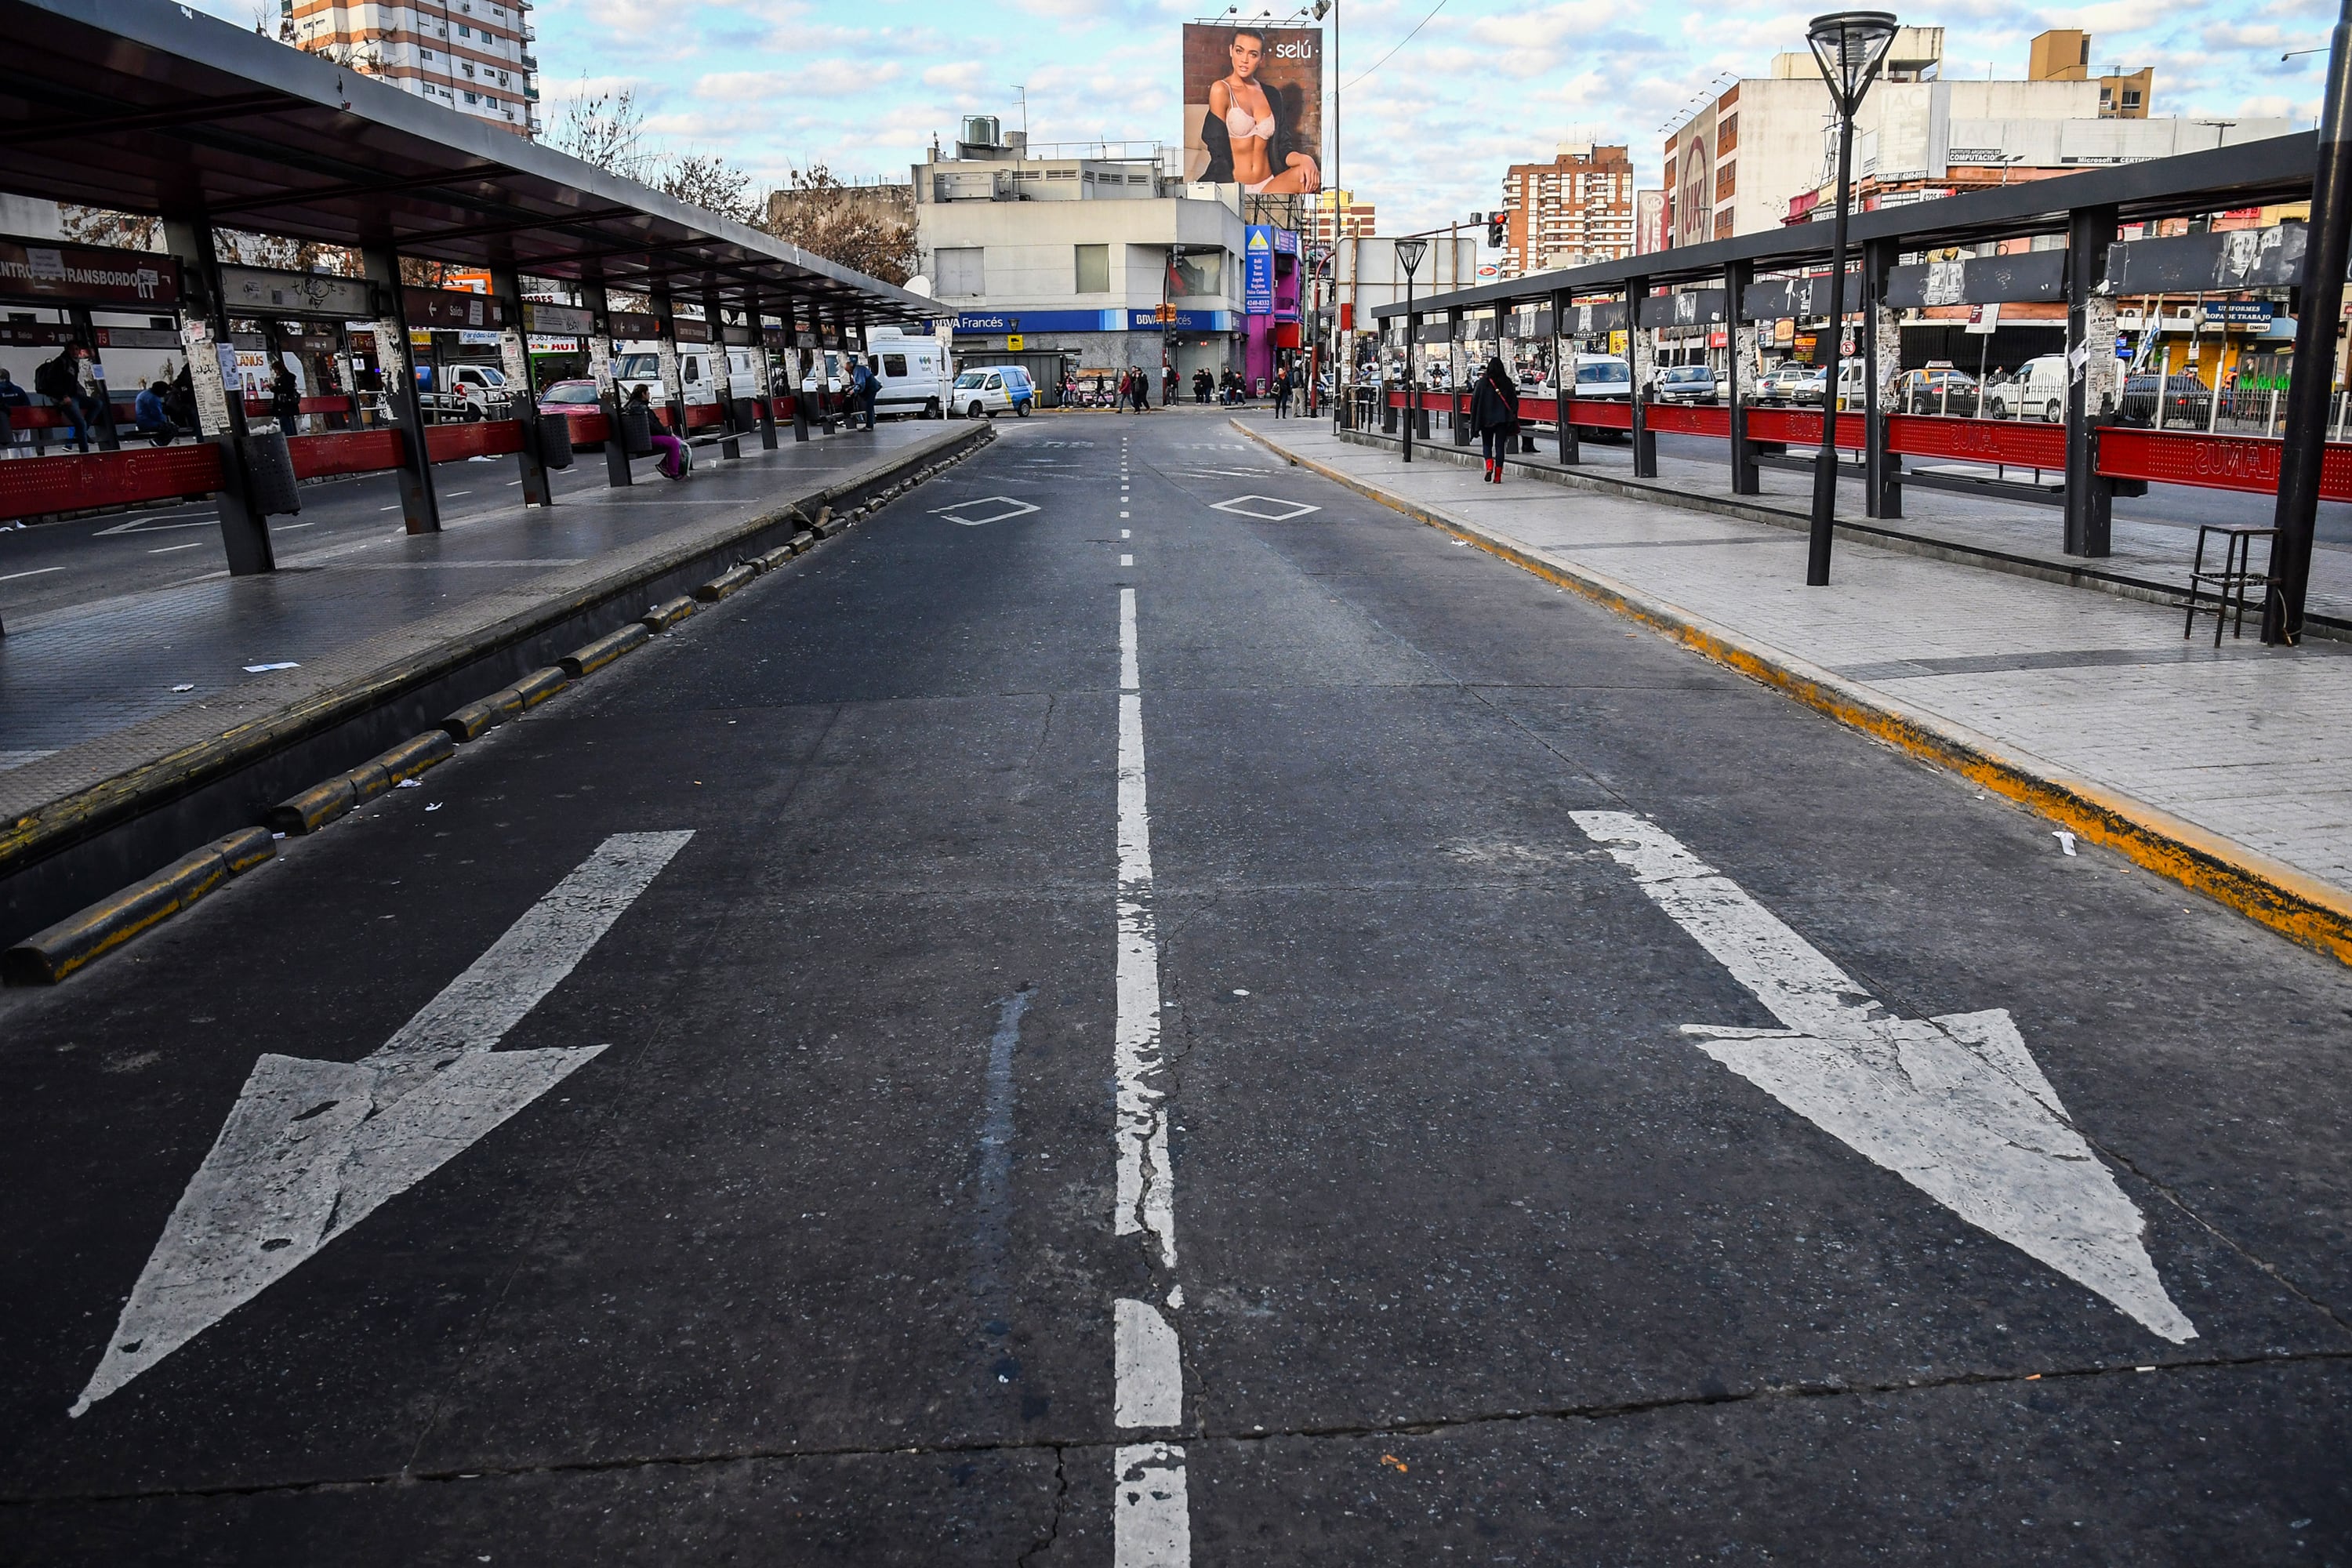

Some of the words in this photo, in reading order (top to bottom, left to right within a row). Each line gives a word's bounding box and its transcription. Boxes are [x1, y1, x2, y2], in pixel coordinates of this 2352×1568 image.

[1276, 39, 1312, 59] selú
[1686, 177, 1704, 235] UK
[62, 267, 137, 289] TRANSBORDO
[962, 316, 1004, 328] Francés
[97, 333, 107, 344] 75
